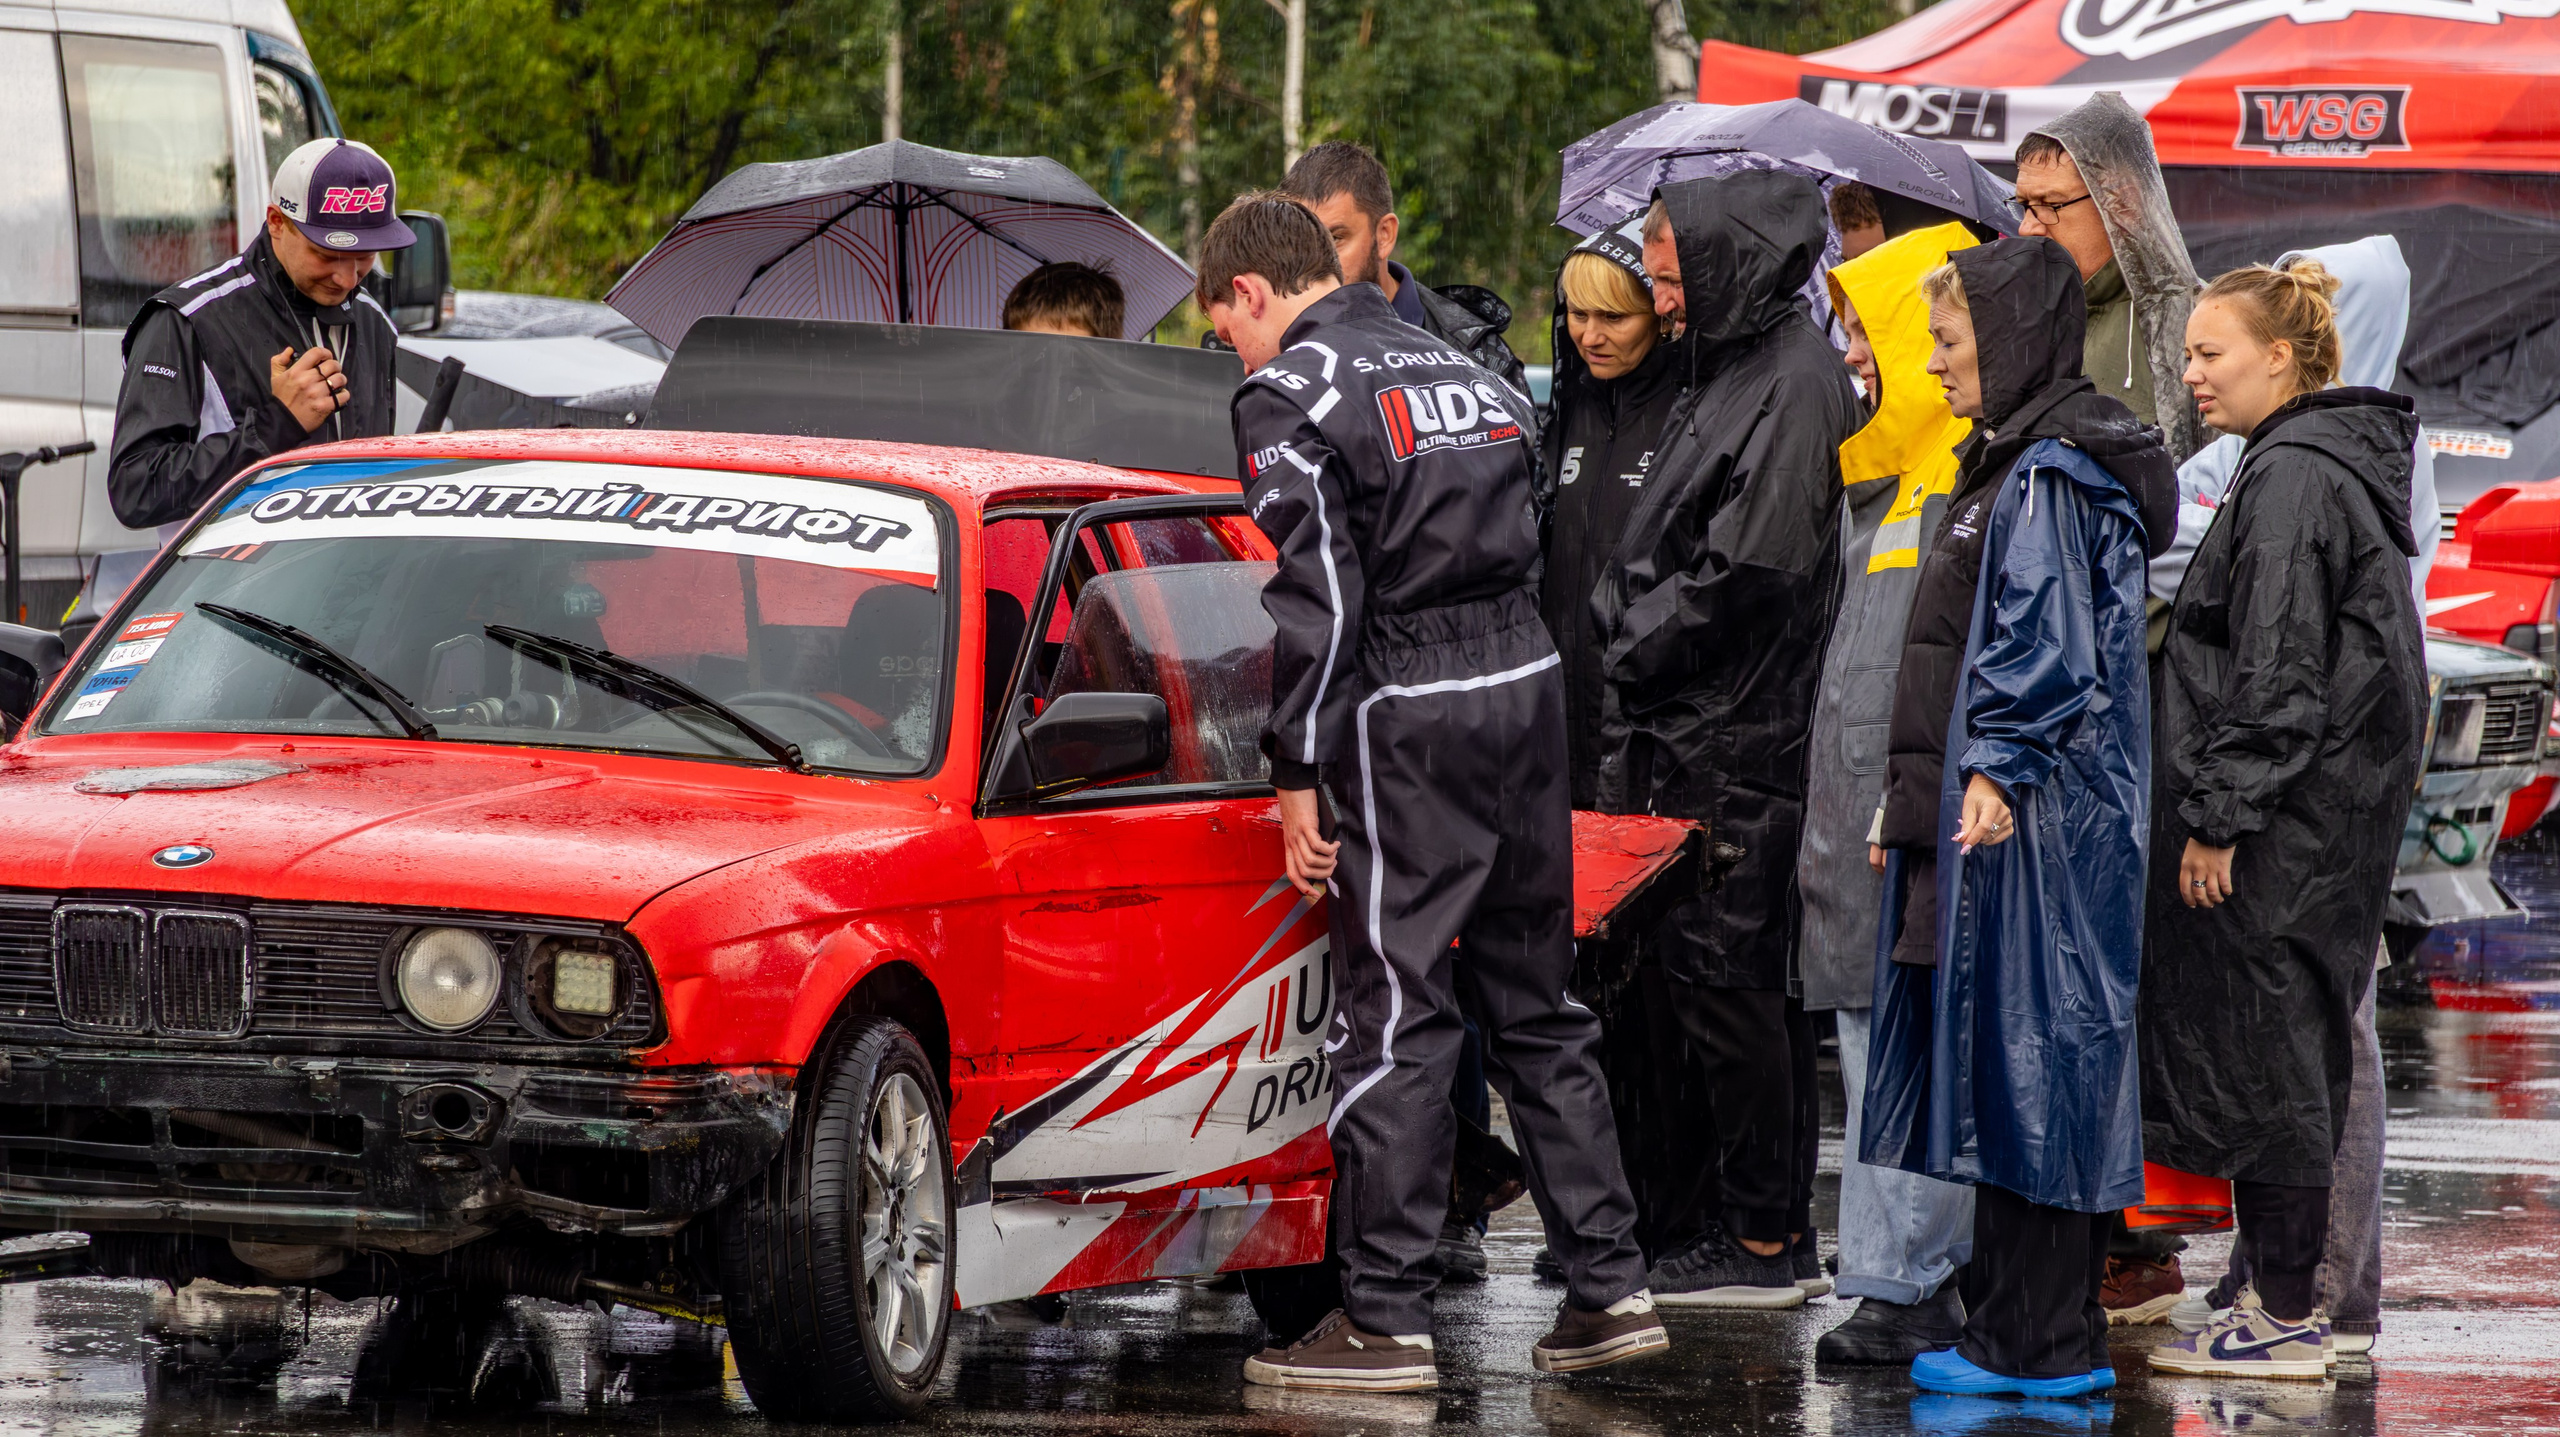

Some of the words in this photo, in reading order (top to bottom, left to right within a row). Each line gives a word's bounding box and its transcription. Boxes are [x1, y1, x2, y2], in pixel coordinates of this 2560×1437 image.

[2254, 94, 2389, 141] WSG
[280, 196, 299, 213] RDS
[319, 183, 389, 213] RDS
[1897, 180, 1966, 208] EUROCLIM
[143, 364, 177, 378] VOLSON
[1353, 357, 1383, 373] S.
[1459, 431, 1489, 446] DRIFT
[1490, 425, 1519, 440] SCHO
[251, 482, 630, 522] ОТКРЫТЫЙ
[635, 494, 908, 550] ДРИФТ
[1247, 1046, 1333, 1135] DRI
[1638, 1332, 1664, 1346] PUMA
